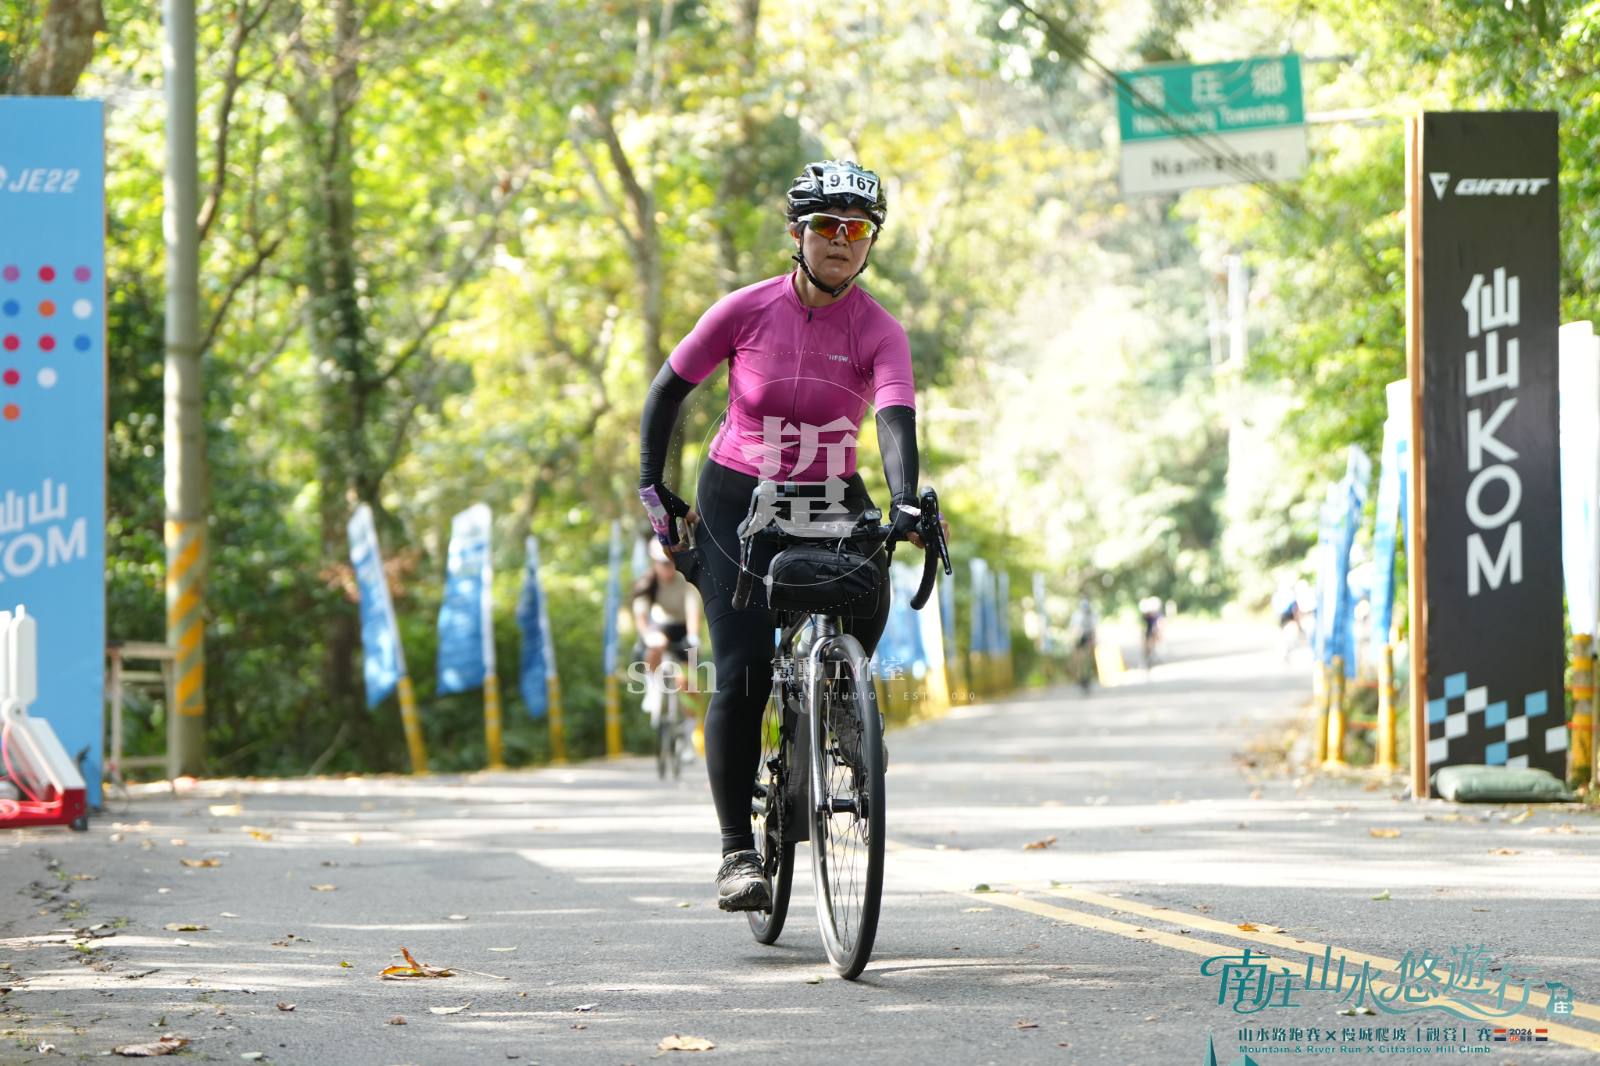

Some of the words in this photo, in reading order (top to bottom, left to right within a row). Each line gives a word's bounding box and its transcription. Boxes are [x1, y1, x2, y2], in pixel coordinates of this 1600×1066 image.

[8, 168, 80, 193] JE22
[1455, 178, 1550, 195] GIANT
[0, 517, 87, 583] OM
